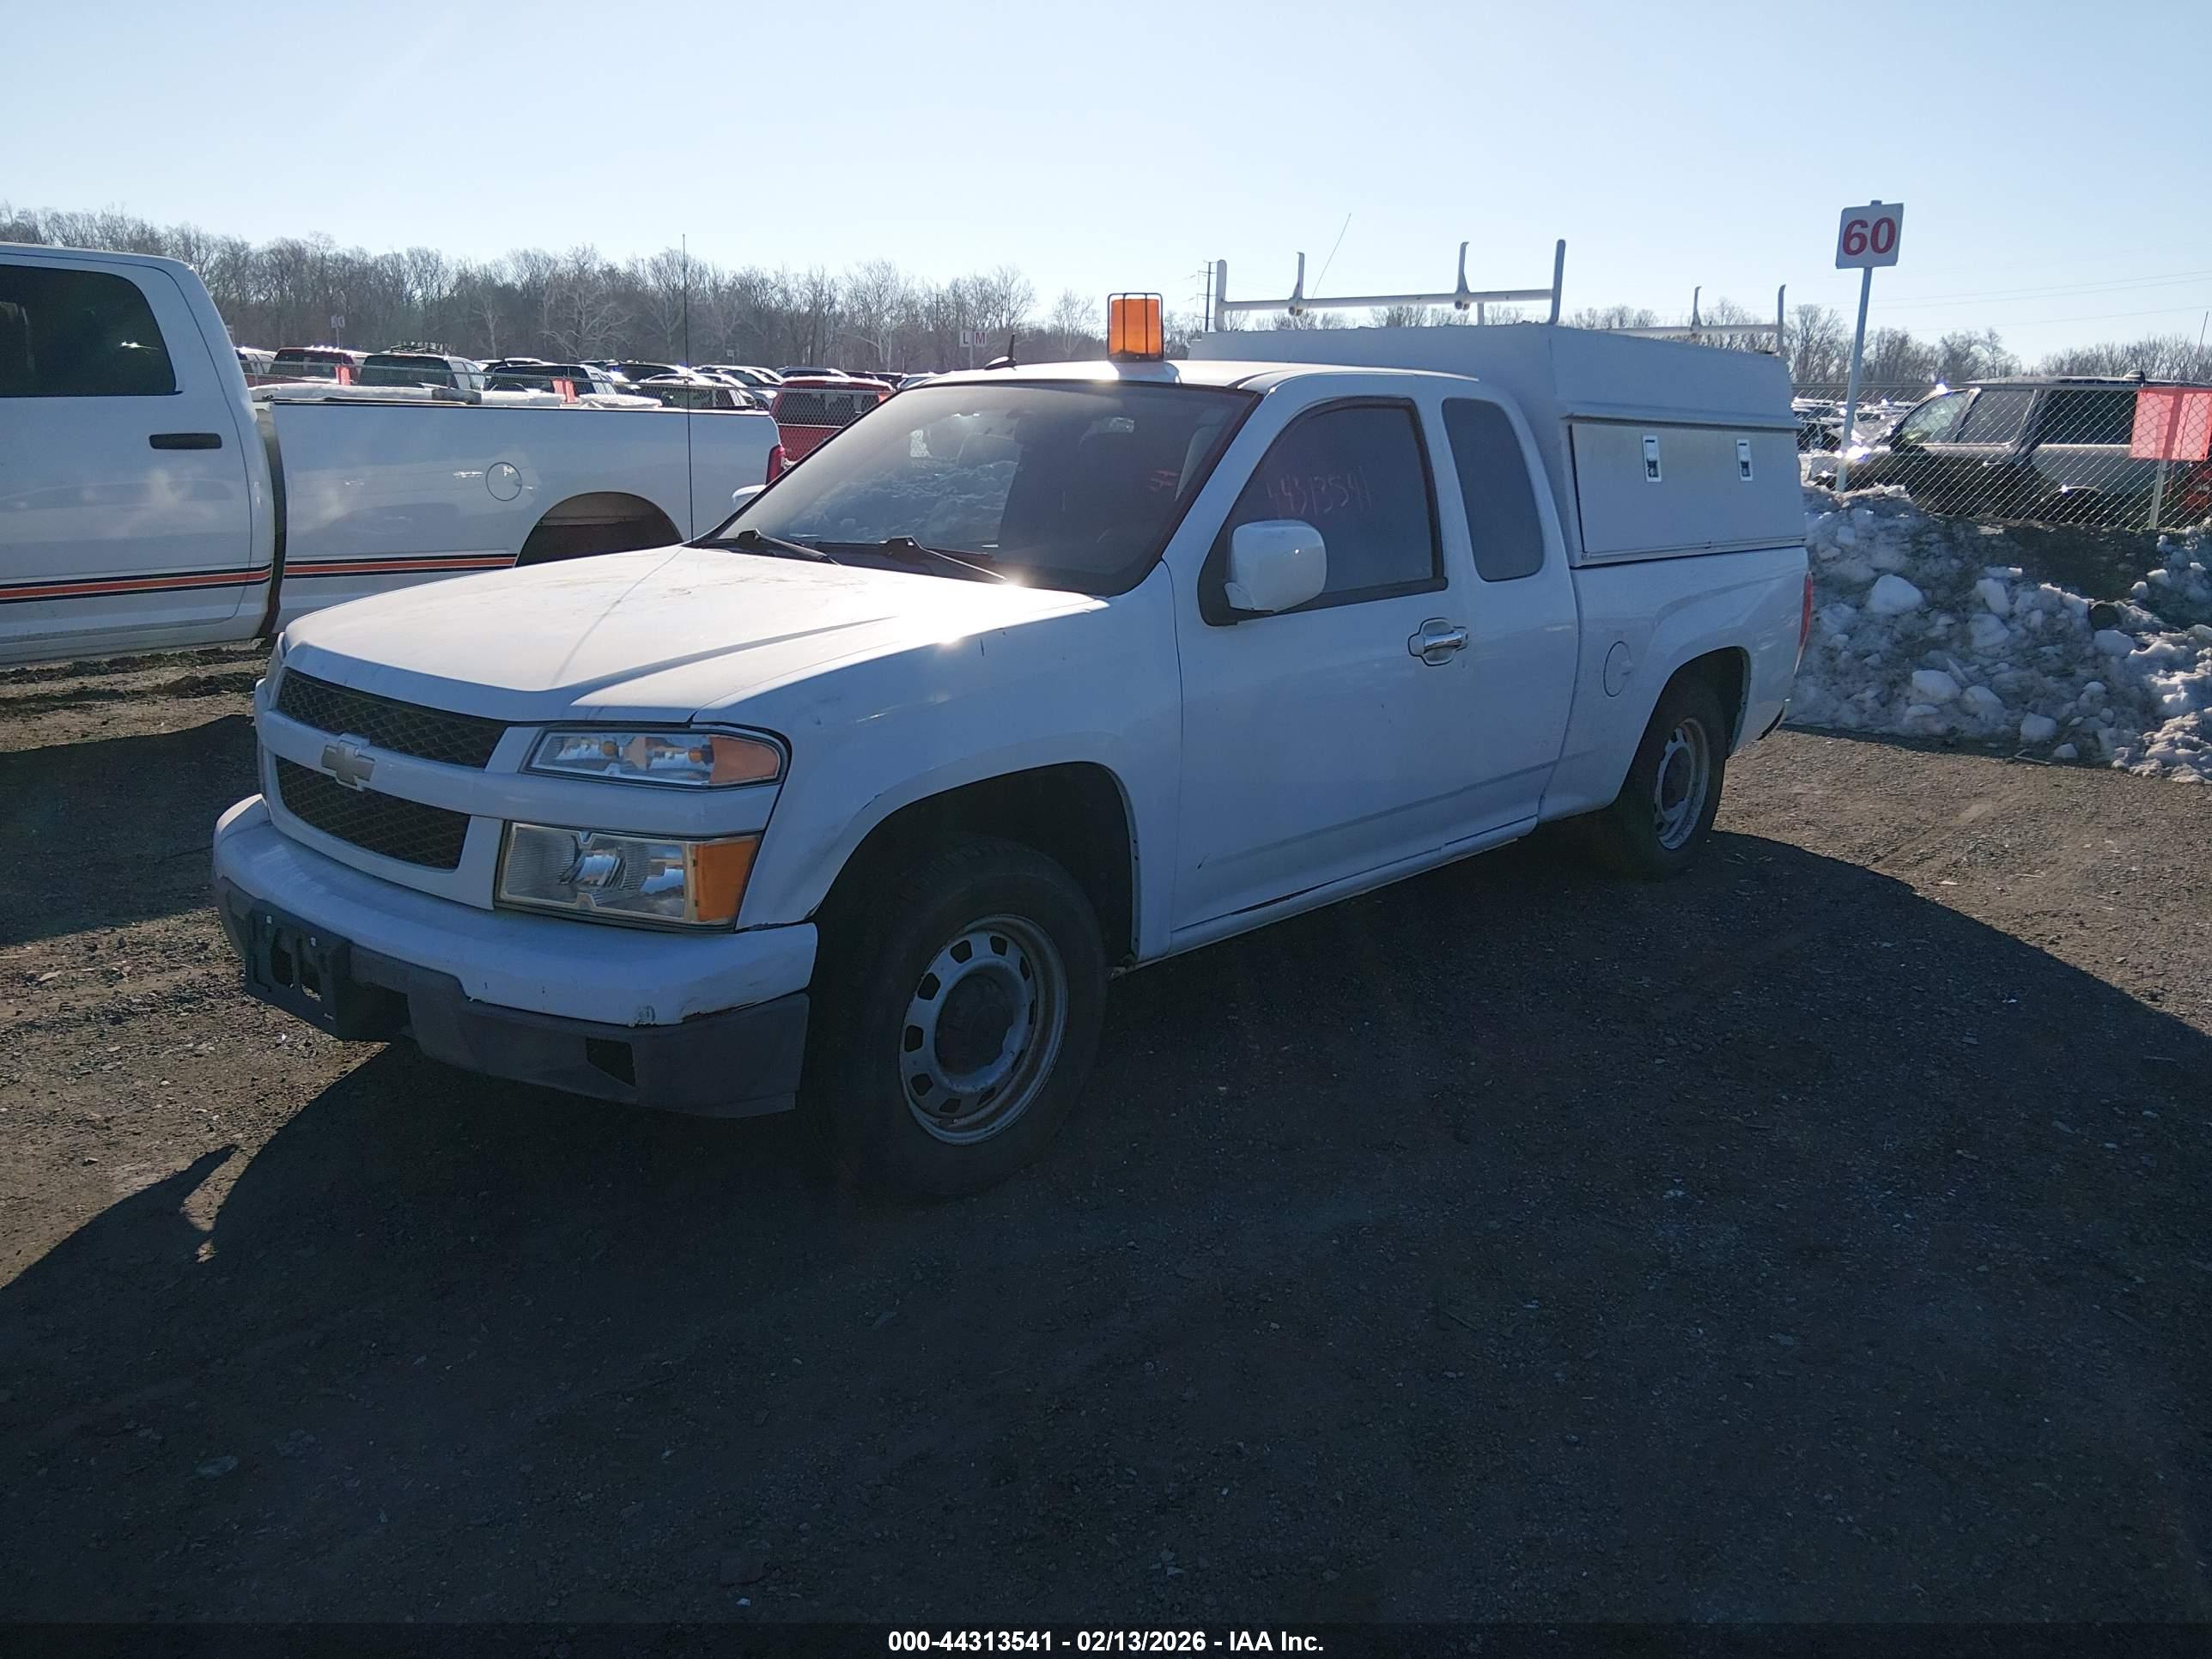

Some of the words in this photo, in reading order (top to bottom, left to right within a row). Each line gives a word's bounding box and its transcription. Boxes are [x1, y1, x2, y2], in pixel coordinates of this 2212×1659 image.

[1842, 216, 1897, 256] 60
[963, 331, 969, 344] L
[975, 331, 986, 344] M
